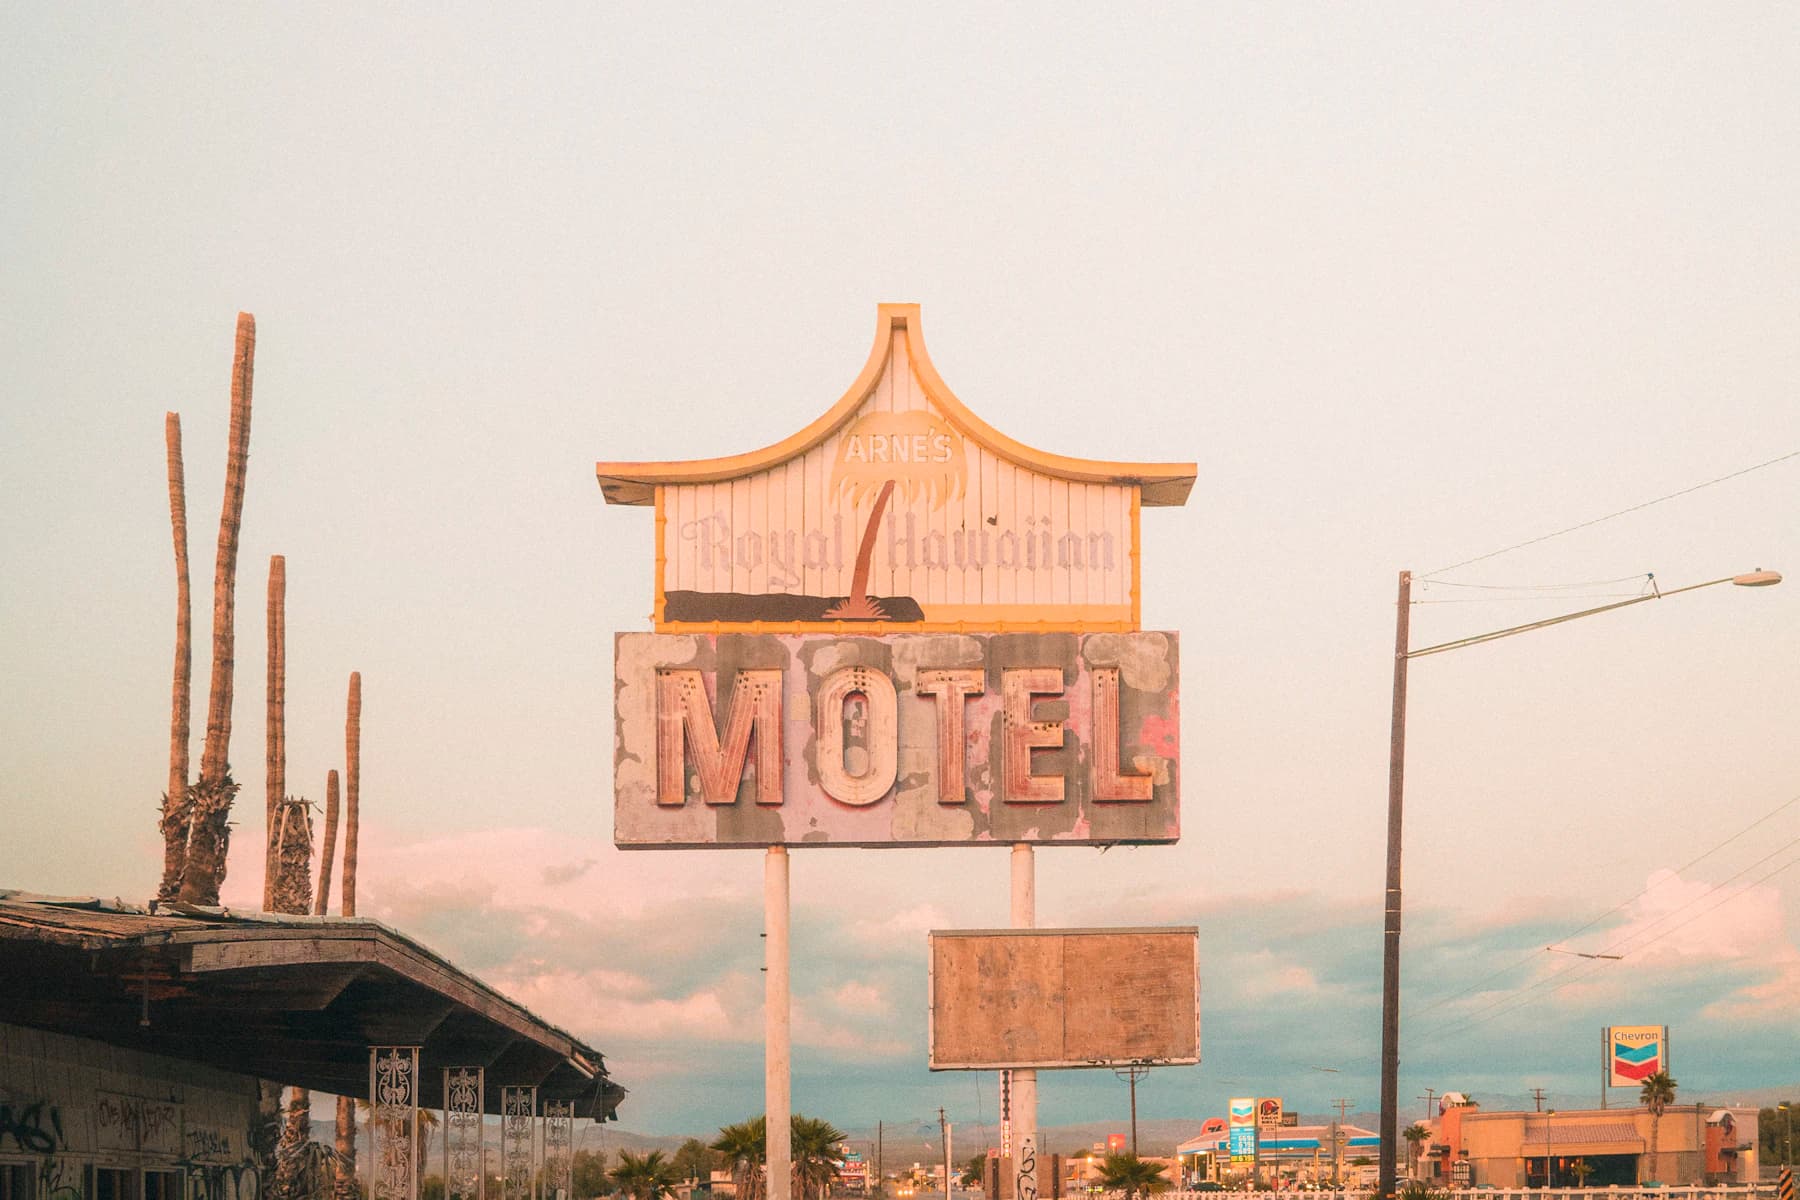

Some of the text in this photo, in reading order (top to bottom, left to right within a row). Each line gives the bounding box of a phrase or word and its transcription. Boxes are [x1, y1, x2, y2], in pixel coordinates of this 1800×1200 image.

[844, 427, 953, 464] ARNE'S
[681, 511, 1116, 587] Royal Hawaiian
[655, 666, 1154, 805] MOTEL
[1614, 1032, 1658, 1041] Chevron
